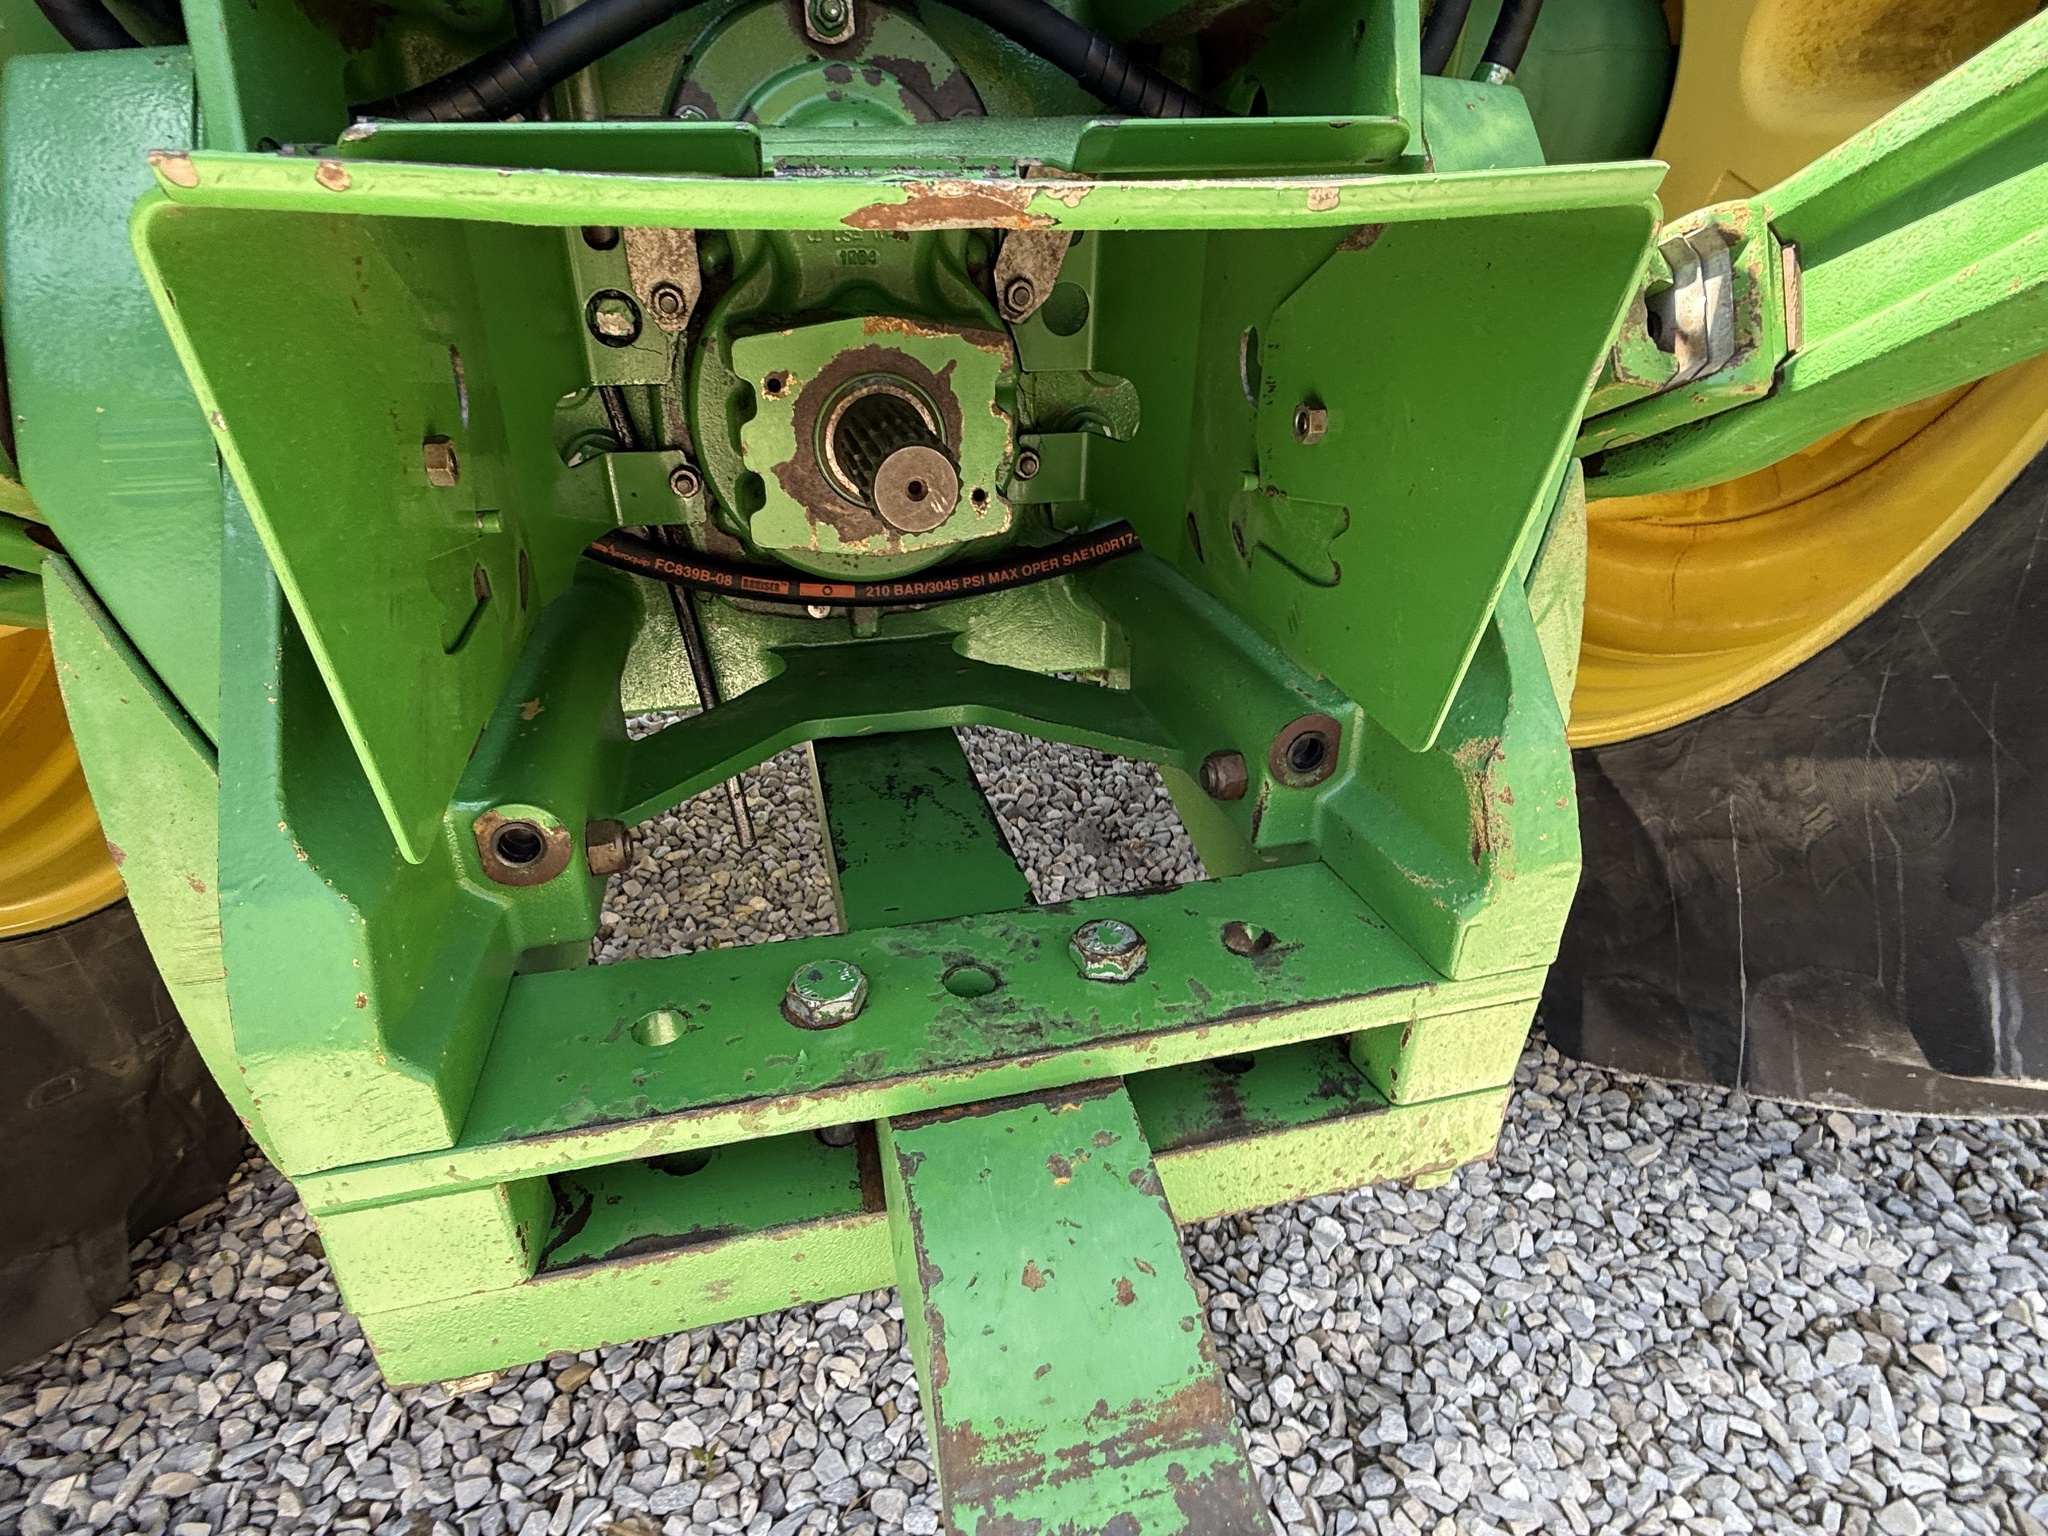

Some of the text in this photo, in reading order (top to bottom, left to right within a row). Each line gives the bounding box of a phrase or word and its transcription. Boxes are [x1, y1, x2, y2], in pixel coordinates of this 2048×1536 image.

[654, 558, 733, 586] FC839B-08
[866, 585, 890, 597] 210
[893, 579, 959, 597] BAR/3045
[962, 575, 985, 589] PSI
[988, 568, 1019, 586] MAX
[1021, 557, 1059, 577] OPER
